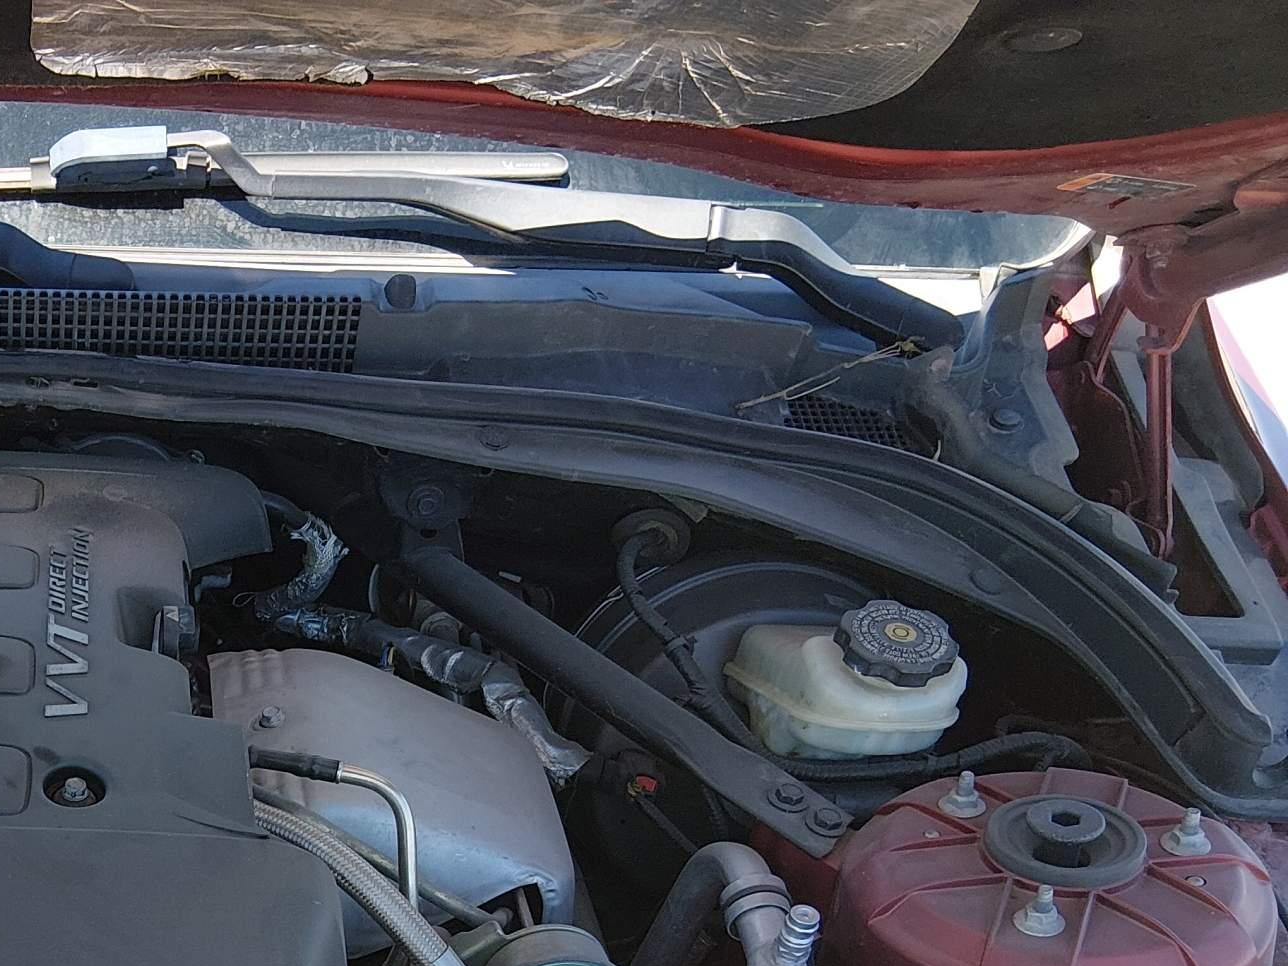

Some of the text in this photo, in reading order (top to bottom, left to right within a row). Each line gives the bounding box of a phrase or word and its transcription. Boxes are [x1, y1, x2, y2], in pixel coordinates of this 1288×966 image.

[48, 544, 66, 614] DIRECT
[71, 527, 90, 623] INJECTION
[44, 613, 89, 717] VVT
